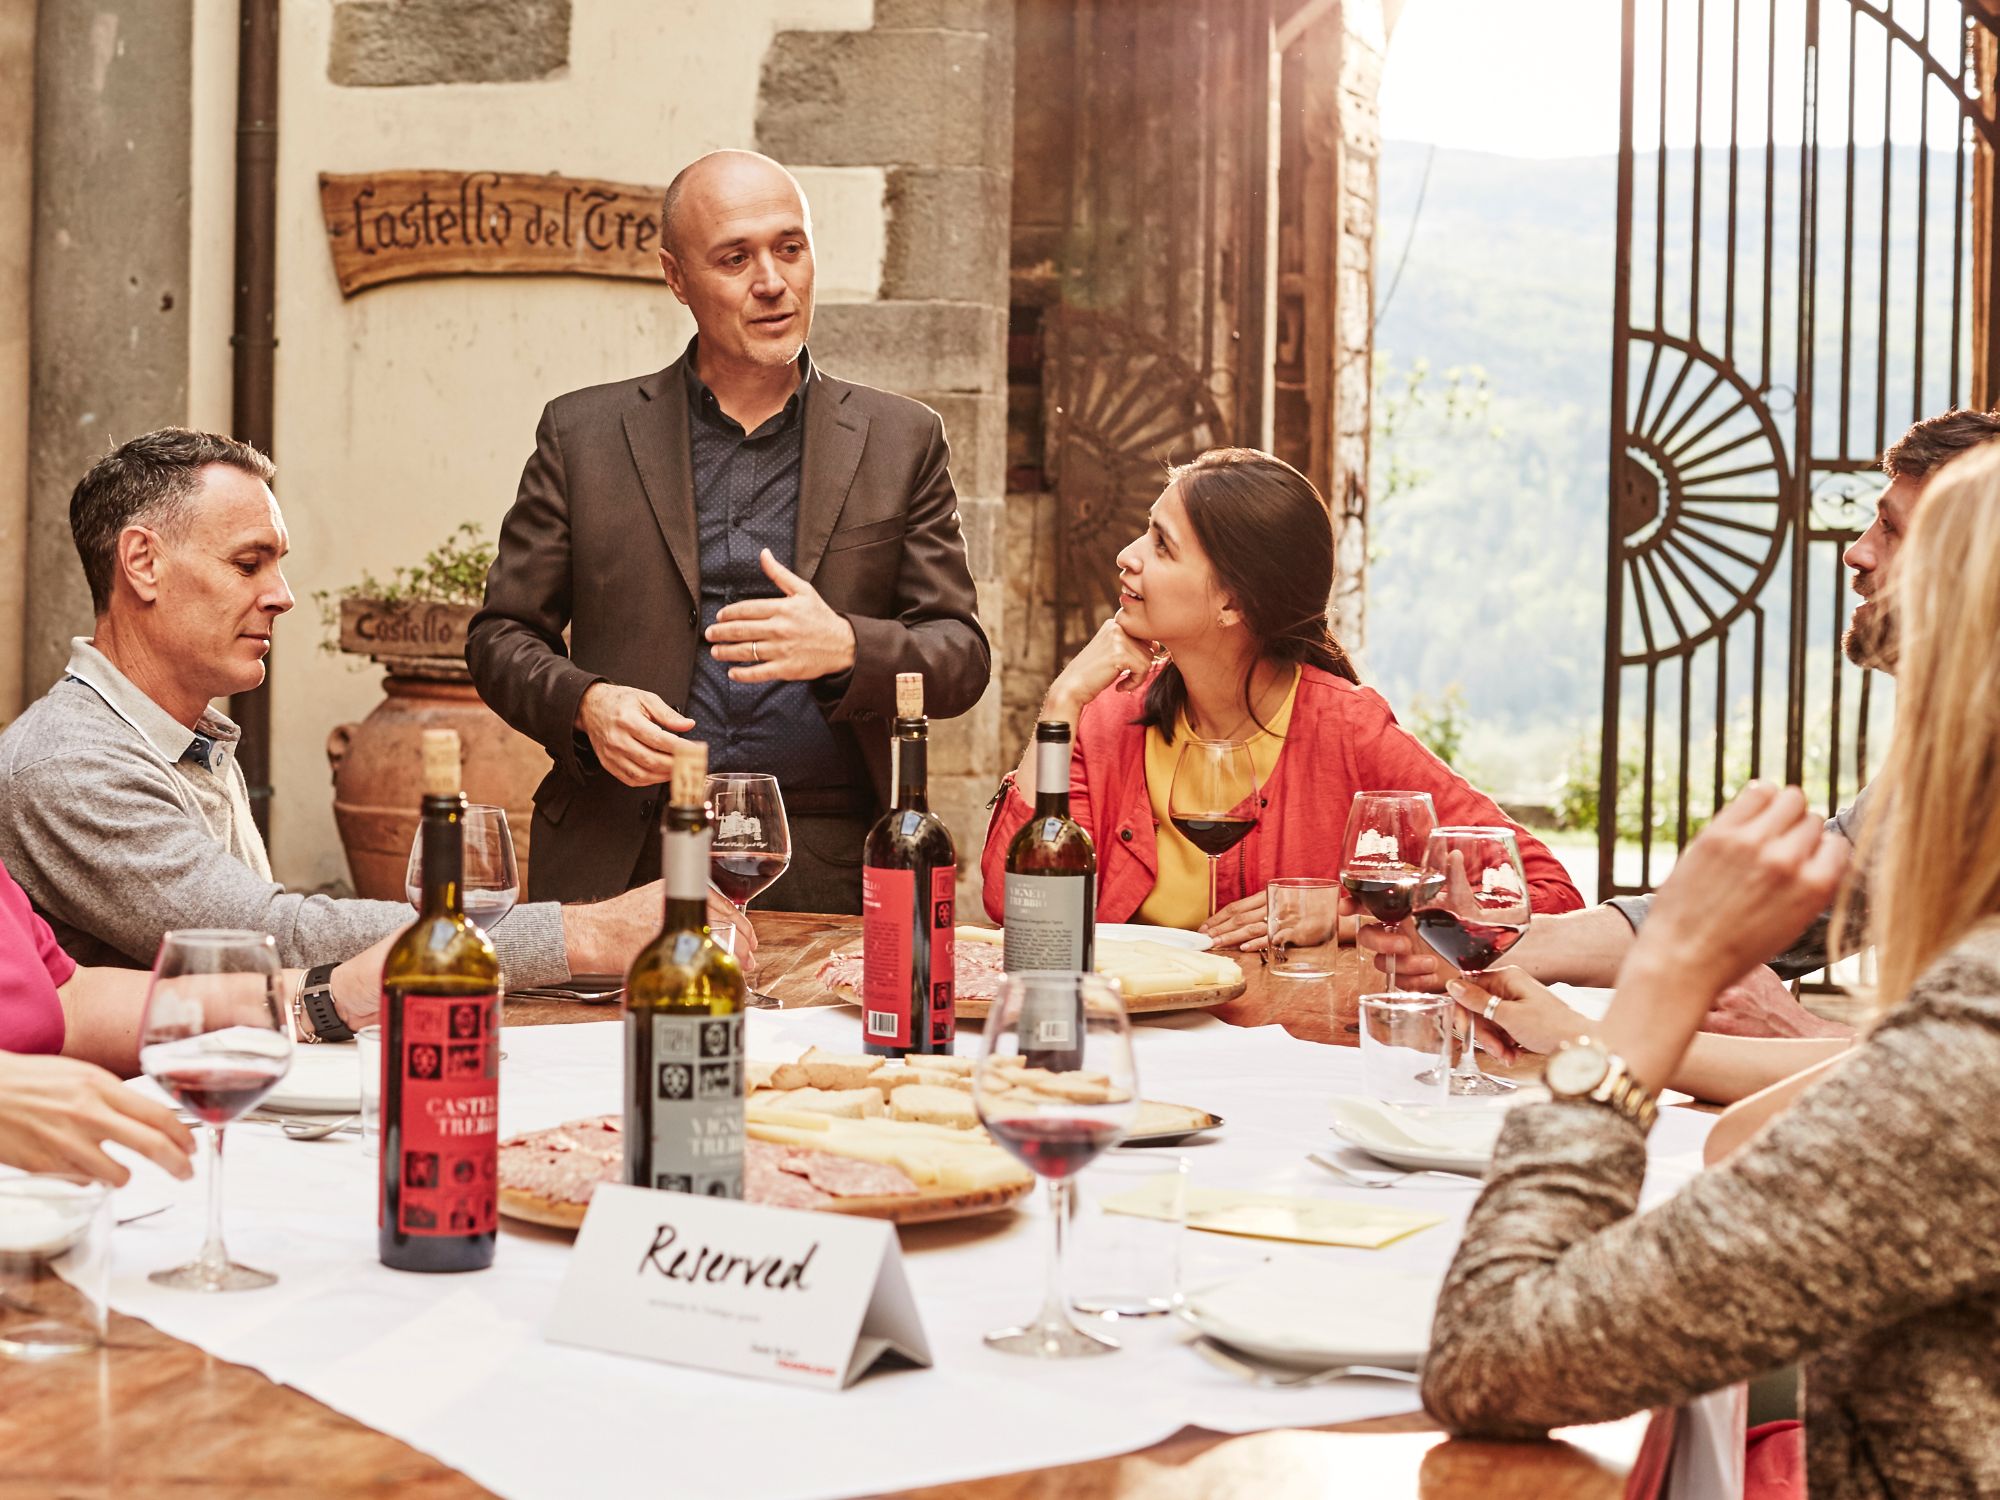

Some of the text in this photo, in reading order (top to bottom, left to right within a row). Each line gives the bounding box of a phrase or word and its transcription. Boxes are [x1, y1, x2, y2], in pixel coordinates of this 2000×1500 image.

[353, 171, 512, 255] Castello
[525, 187, 581, 248] del
[638, 1223, 820, 1291] Reserved
